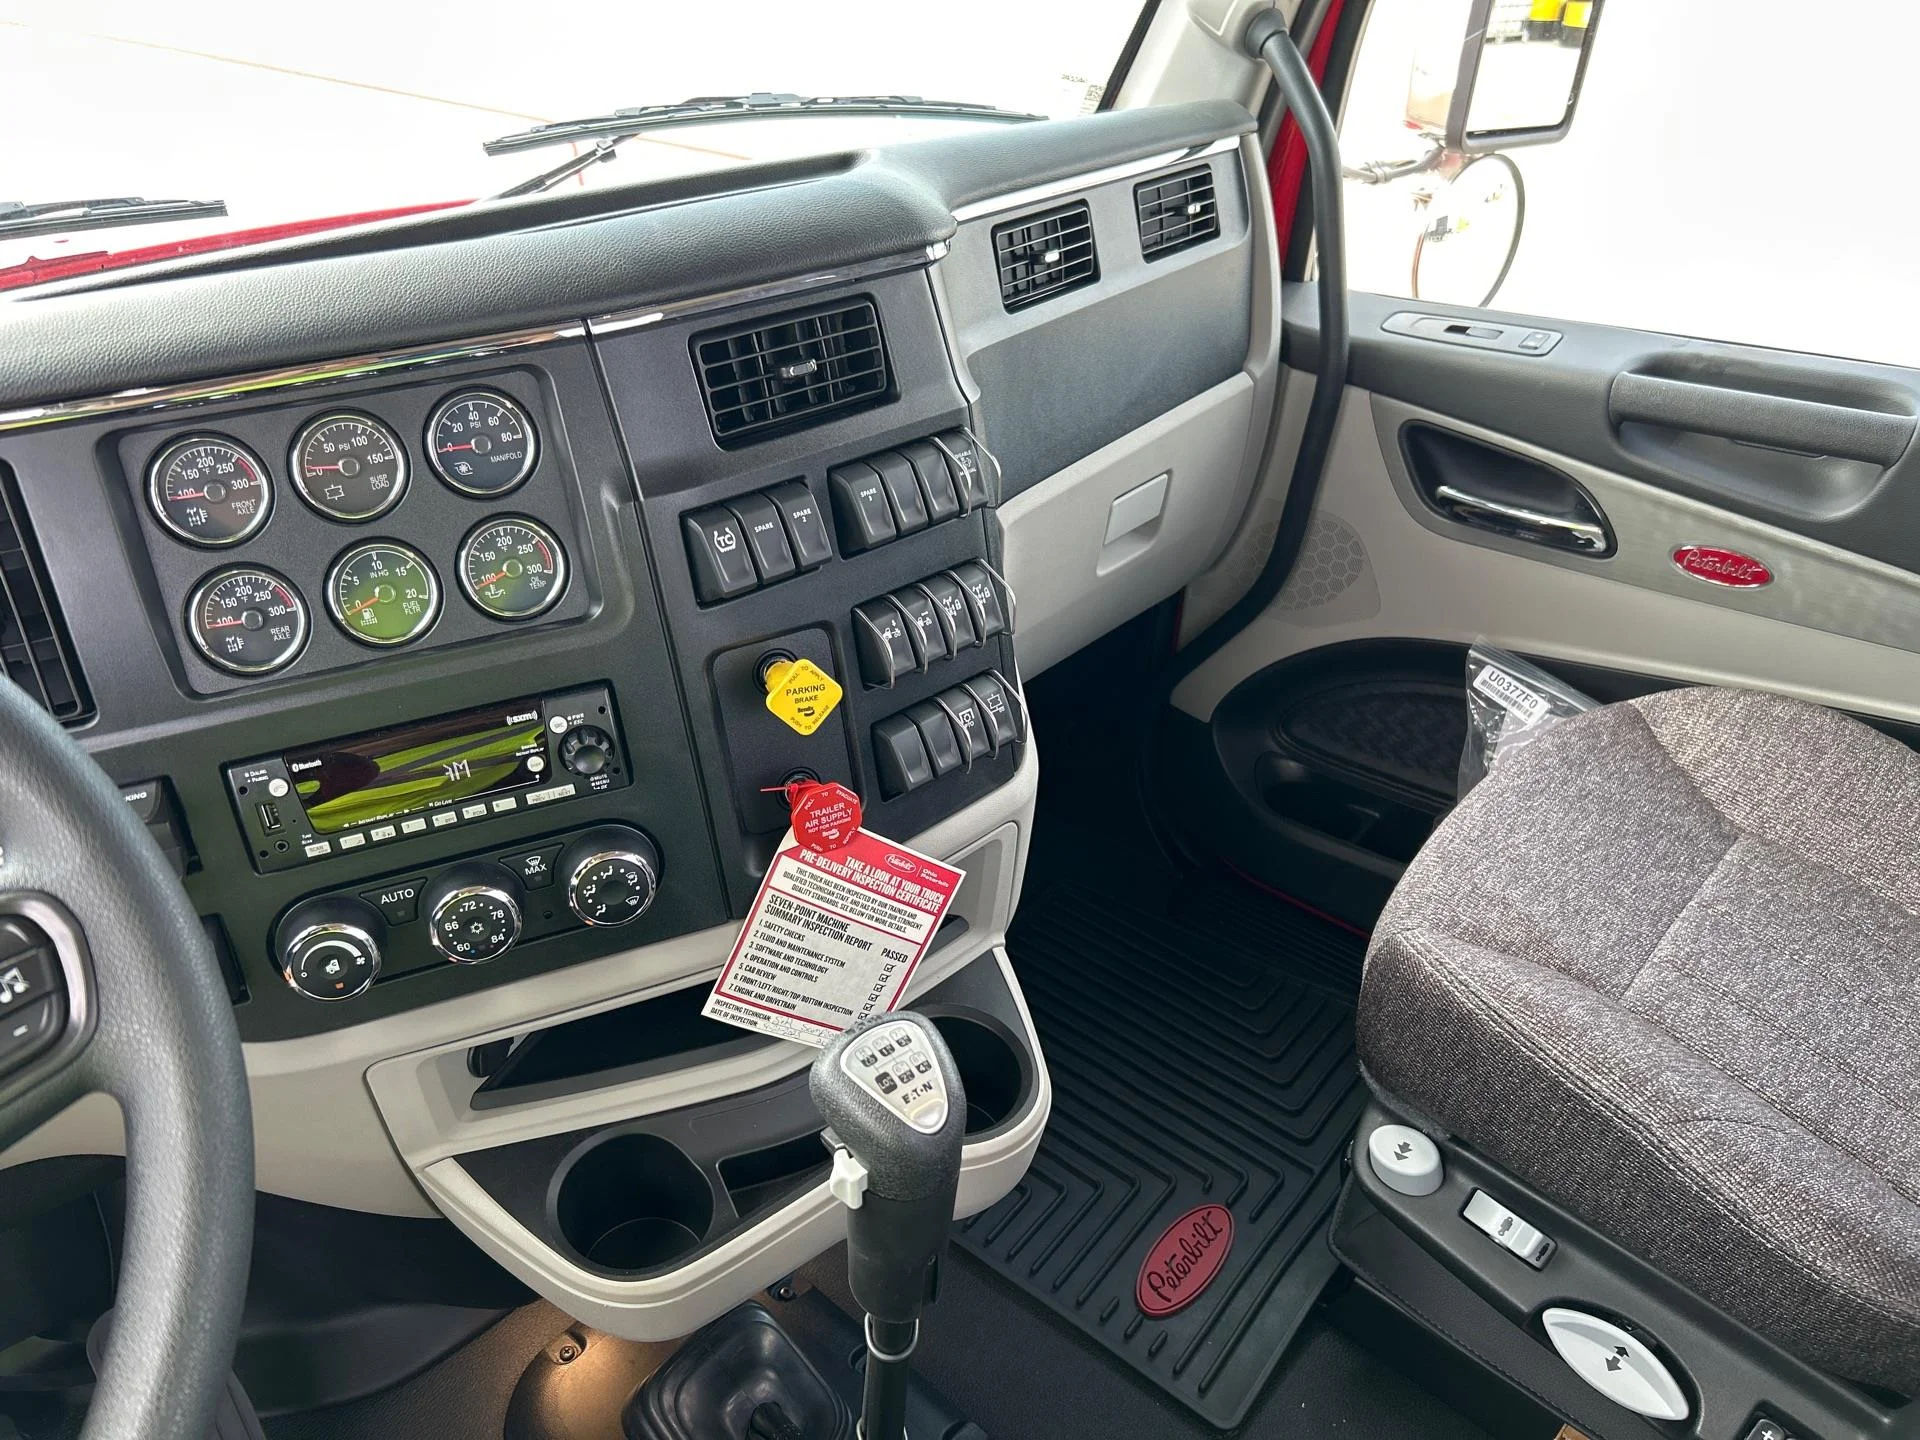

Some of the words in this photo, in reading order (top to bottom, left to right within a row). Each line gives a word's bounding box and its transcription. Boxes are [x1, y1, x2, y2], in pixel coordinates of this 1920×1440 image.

[468, 411, 479, 421] 40
[488, 416, 499, 426] 60
[452, 422, 463, 433] 20
[351, 436, 368, 447] 100
[501, 432, 512, 442] 80
[324, 443, 335, 453] 50
[339, 443, 350, 451] PSI
[197, 456, 215, 468] 200
[367, 453, 384, 465] 150
[490, 451, 522, 463] MANIFOLD
[182, 468, 199, 480] 150
[216, 463, 235, 475] 250
[231, 478, 249, 490] 300
[370, 474, 387, 484] SUSP
[372, 481, 390, 490] LOAD
[860, 487, 877, 498] SPARE
[231, 499, 256, 510] FRONT
[237, 507, 256, 516] AXLE
[792, 508, 812, 519] SPARE
[754, 522, 774, 533] SPARE
[496, 536, 512, 547] 200
[518, 544, 534, 554] 250
[480, 552, 496, 562] 150
[371, 560, 382, 570] 10
[527, 564, 542, 575] 300
[1683, 549, 1763, 581] Peterbilt
[370, 571, 377, 579] IN
[378, 569, 389, 577] HG
[395, 567, 407, 576] 15
[353, 576, 360, 585] 5
[481, 573, 496, 583] 100
[530, 581, 546, 590] TEMP
[235, 586, 252, 597] 200
[254, 590, 271, 602] 250
[406, 588, 417, 598] 20
[220, 598, 237, 608] 150
[355, 600, 361, 608] 0
[403, 601, 420, 609] FUEL
[268, 605, 286, 617] 300
[404, 607, 421, 615] FLTR
[271, 625, 290, 635] REAR
[273, 632, 291, 641] AXLE
[786, 683, 826, 697] PARKING
[1488, 670, 1539, 710] U0377F0
[794, 694, 819, 705] BRAKE
[810, 802, 846, 819] TRAILER
[804, 818, 820, 829] AIR
[820, 807, 853, 824] SUPPLY
[807, 826, 821, 834] NOT
[525, 864, 548, 875] MAX
[922, 868, 937, 877] Ohio
[799, 848, 853, 878] PRE-DELIVERY
[851, 870, 896, 896] INSPECTION
[895, 888, 940, 913] CERTIFICATE
[844, 855, 865, 872] TAKE
[862, 864, 870, 875] A
[869, 866, 891, 883] LOOK
[888, 875, 901, 886] AT
[900, 879, 921, 895] YOUR
[920, 887, 945, 904] TRUCK
[380, 888, 415, 905] AUTO
[795, 866, 807, 876] THIS
[807, 871, 823, 883] TRUCK
[822, 878, 833, 887] HAS
[832, 882, 846, 892] BEEN
[845, 887, 871, 902] INSPECTED
[877, 900, 888, 908] OUR
[887, 903, 907, 916] TRAINED
[906, 911, 917, 919] AND
[782, 870, 807, 885] QUALIFIED
[806, 880, 835, 897] TECHNICIAN
[849, 898, 860, 907] AND
[859, 902, 870, 910] HAS
[869, 906, 887, 917] PASSED
[887, 912, 897, 921] OUR
[896, 916, 922, 930] STRINGENT
[791, 883, 812, 896] QUALITY
[839, 903, 849, 911] SEE
[848, 906, 865, 917] BELOW
[864, 912, 874, 921] FOR
[873, 916, 888, 926] MORE
[462, 901, 477, 912] 72
[491, 909, 505, 921] 78
[768, 893, 817, 919] SEVEN-POINT
[815, 912, 850, 932] MACHINE
[444, 921, 460, 932] 66
[763, 920, 784, 933] SAFETY
[783, 928, 805, 941] CHECKS
[764, 903, 803, 925] SUMMARY
[801, 918, 845, 941] INSPECTION
[843, 934, 872, 951] REPORT
[490, 932, 505, 944] 84
[456, 941, 471, 953] 60
[759, 931, 775, 943] FLUID
[774, 938, 787, 947] AND
[786, 942, 824, 961] MAINTENANCE
[823, 955, 845, 968] SYSTEM
[754, 943, 783, 959] SOFTWARE
[782, 953, 794, 962] AND
[794, 957, 829, 974] TECHNOLOGY
[880, 947, 908, 963] PASSED
[744, 964, 756, 973] CAB
[755, 968, 777, 980] REVIEW
[749, 953, 780, 969] OPERATION
[778, 964, 791, 973] AND
[790, 968, 818, 982] CONTROLS
[733, 985, 754, 997] ENGINE
[753, 992, 765, 1000] AND
[764, 995, 796, 1010] DRIVETRAIN
[714, 998, 743, 1012] INSPECTING
[822, 1002, 853, 1016] INSPECTION
[710, 1007, 722, 1015] DATE
[1147, 1211, 1224, 1303] Peterbilt
